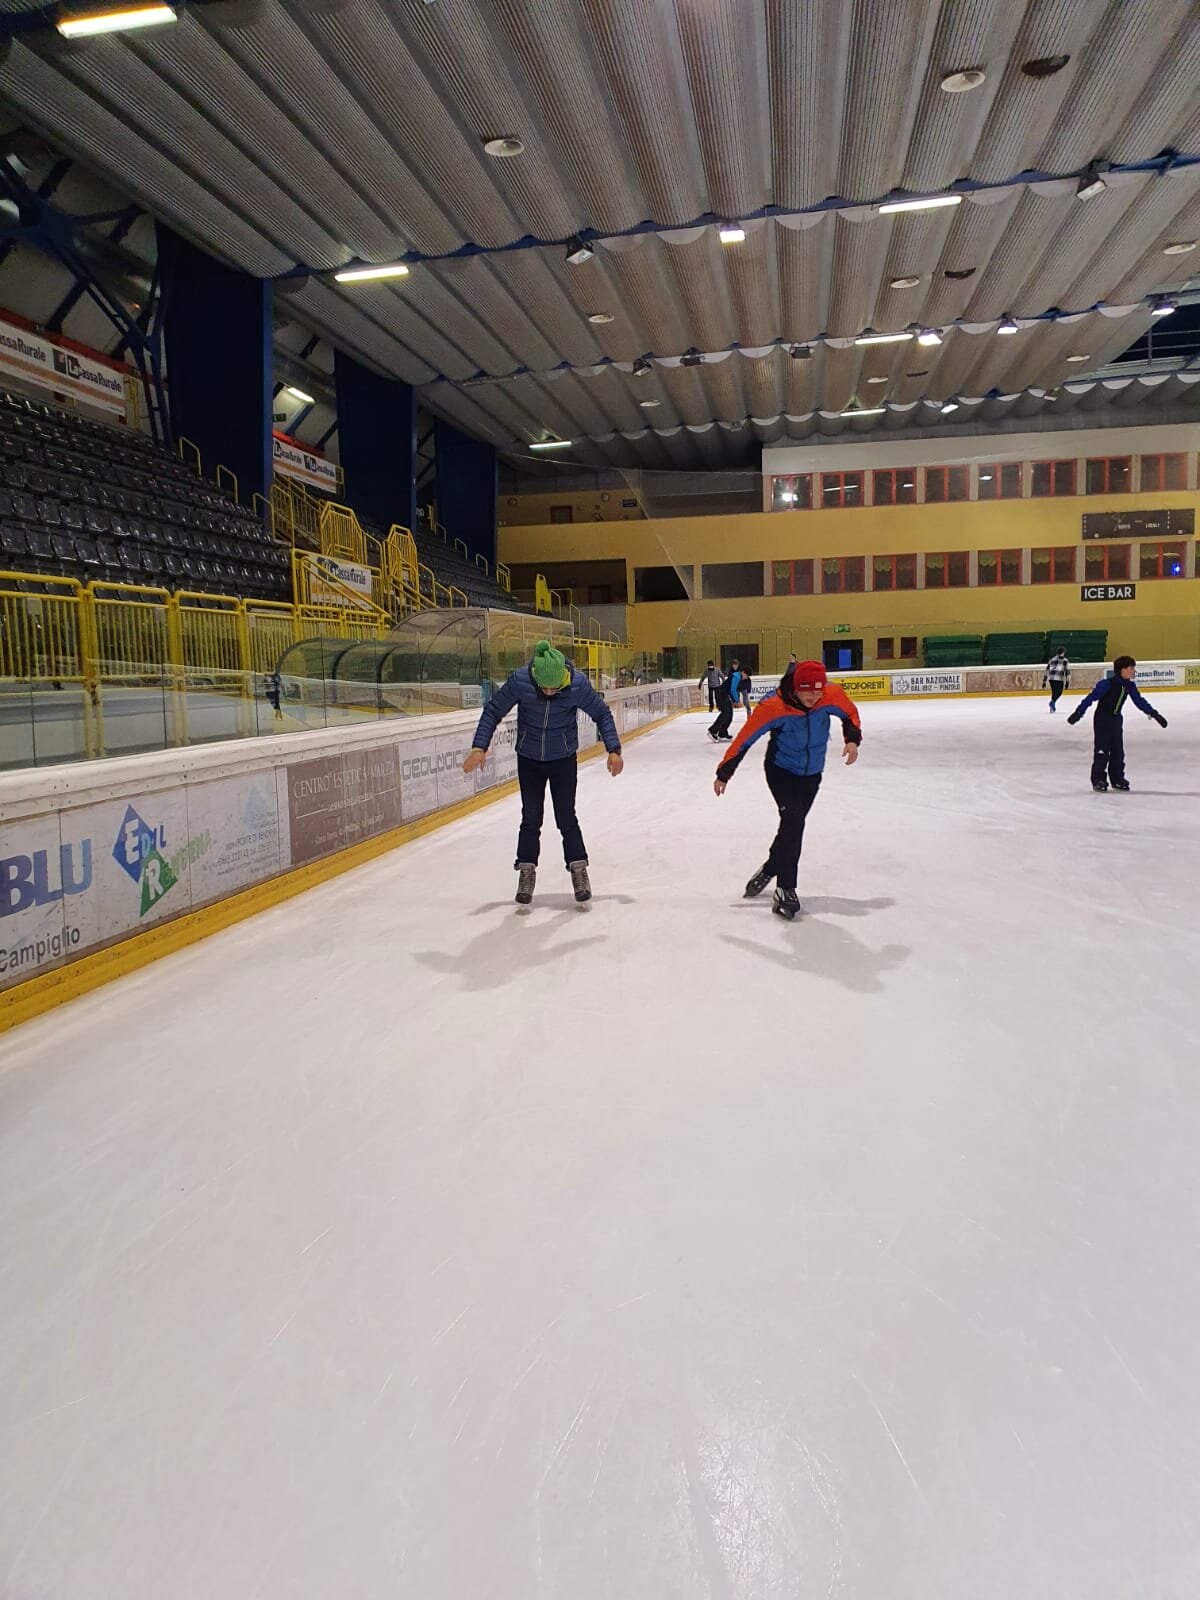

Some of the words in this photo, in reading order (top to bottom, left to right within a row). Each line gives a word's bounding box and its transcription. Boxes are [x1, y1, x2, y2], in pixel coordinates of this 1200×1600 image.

[1084, 588, 1105, 599] ICE
[1108, 586, 1132, 598] BAR
[911, 677, 924, 685] BAR
[926, 675, 960, 684] NAZIONALE
[294, 775, 330, 799] CENTRO
[0, 838, 93, 918] BLU
